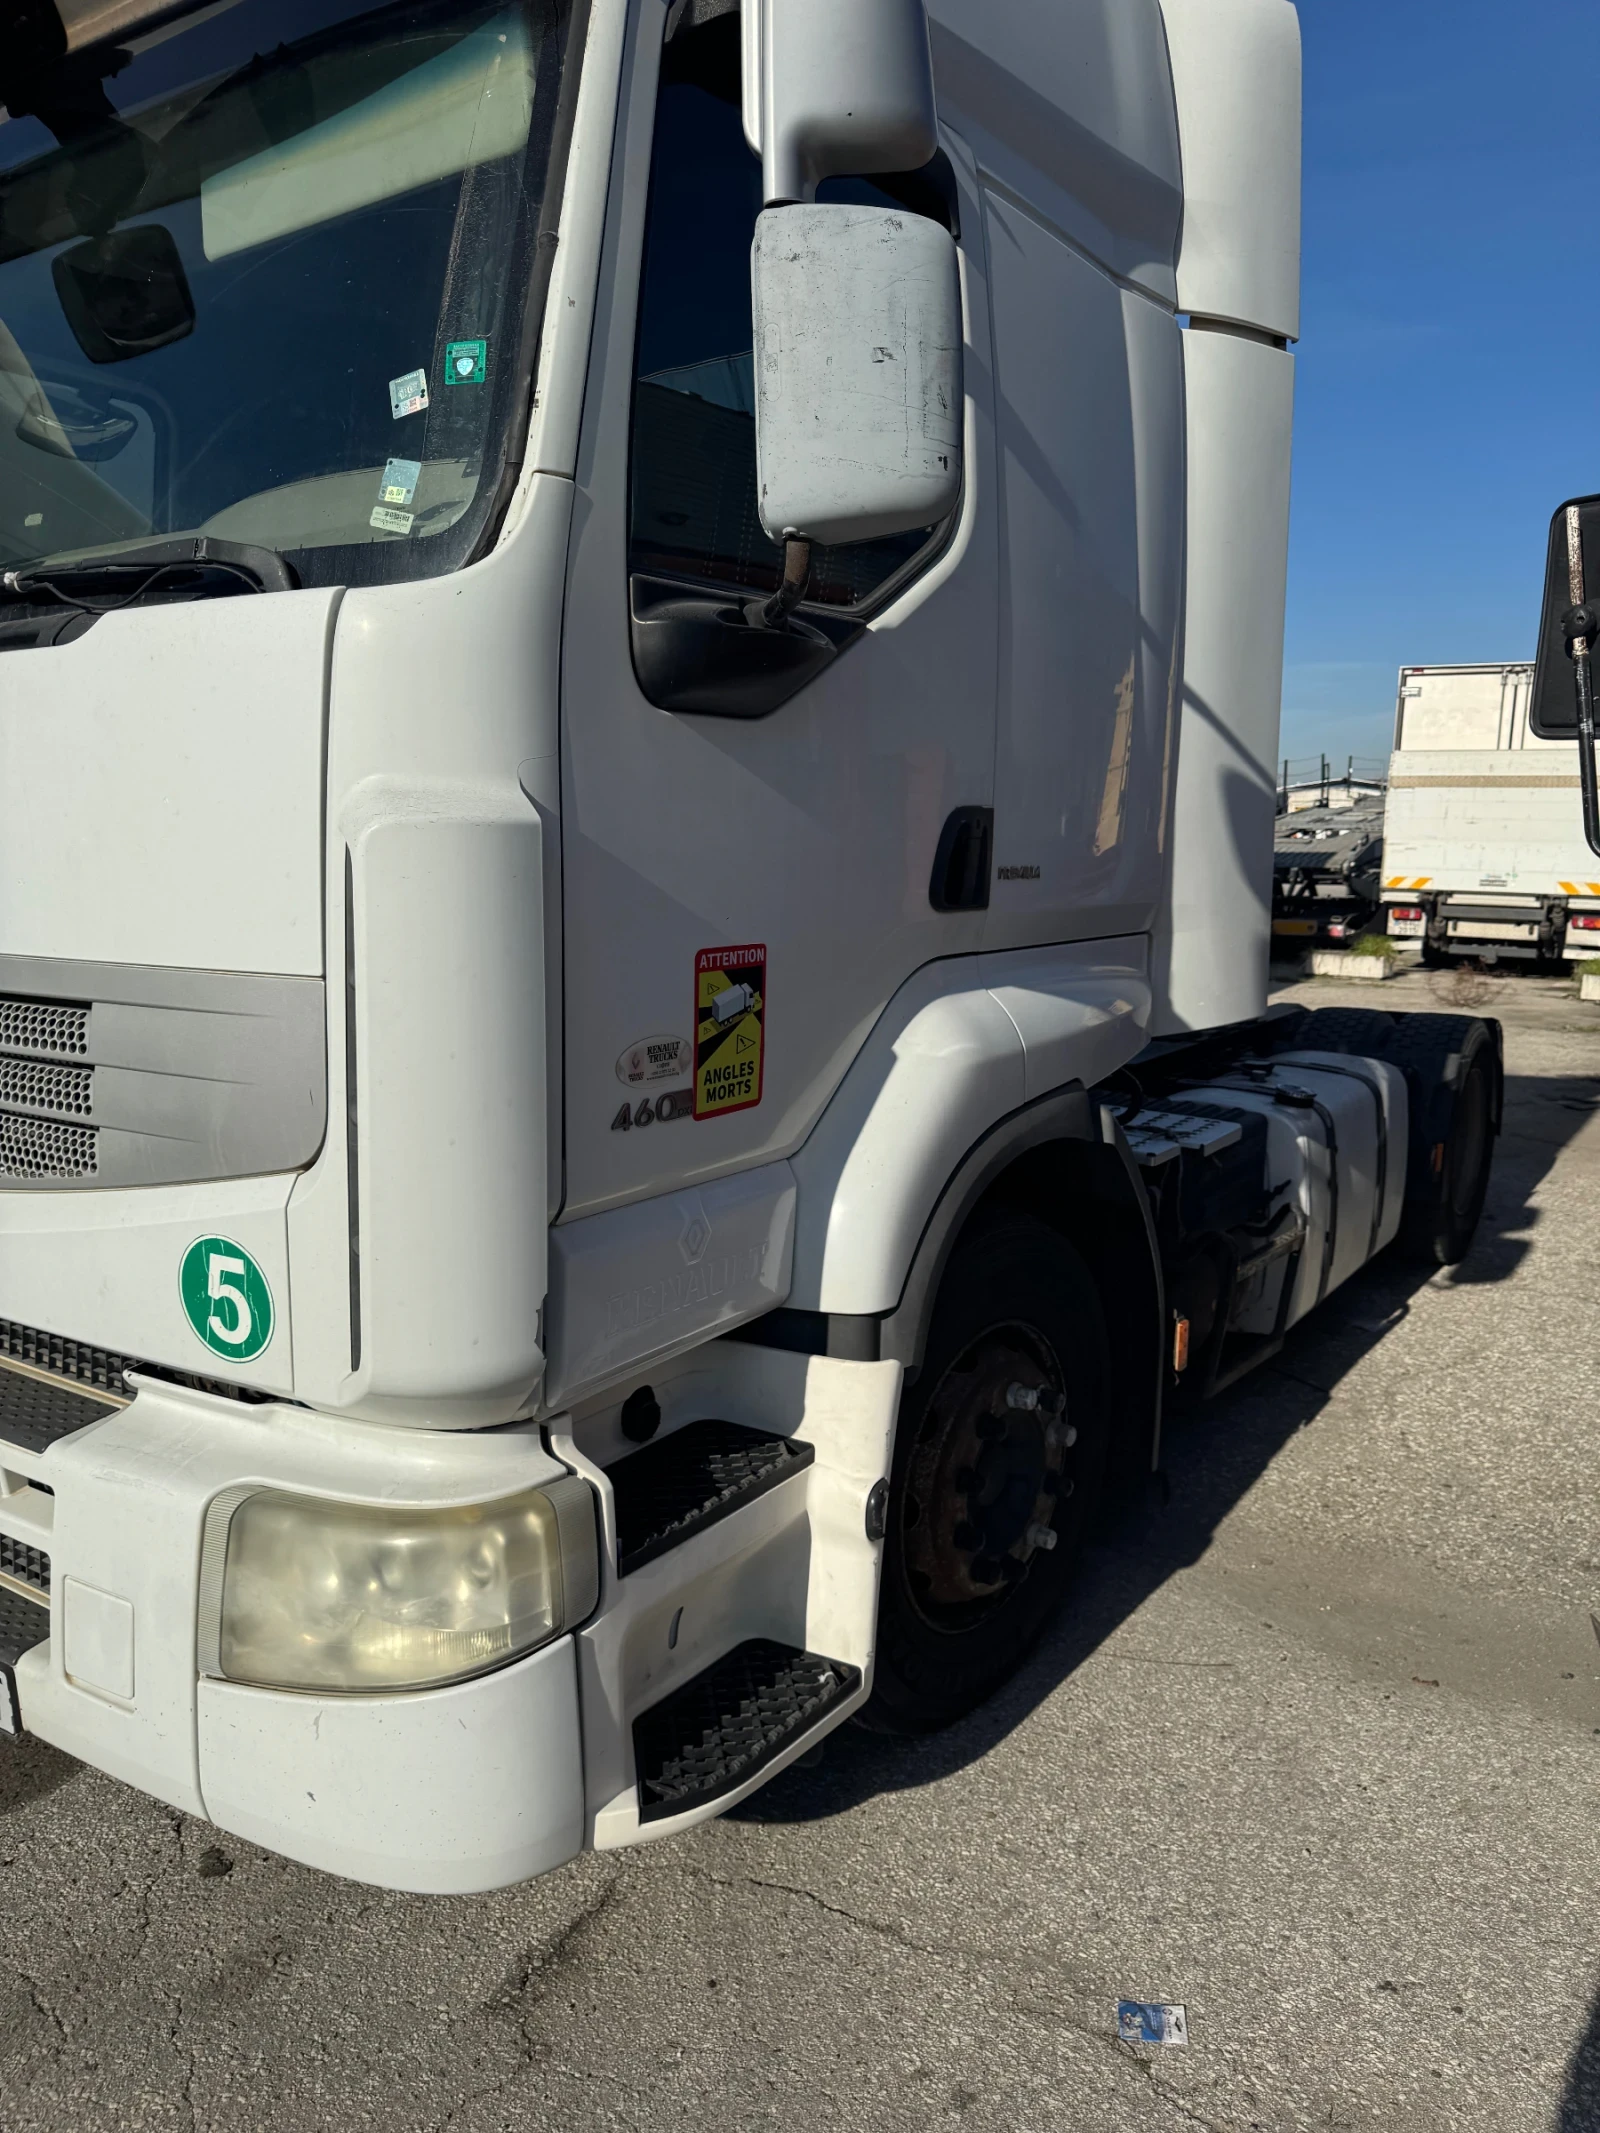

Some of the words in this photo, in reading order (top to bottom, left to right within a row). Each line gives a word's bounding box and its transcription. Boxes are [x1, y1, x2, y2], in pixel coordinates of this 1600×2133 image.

[700, 948, 764, 969] ATTENTION
[647, 1041, 681, 1056] RENAULT
[649, 1050, 679, 1064] TRUCKS
[703, 1060, 755, 1086] ANGLES
[706, 1078, 752, 1103] MORTS
[611, 1092, 676, 1131] 460
[207, 1252, 252, 1345] 5
